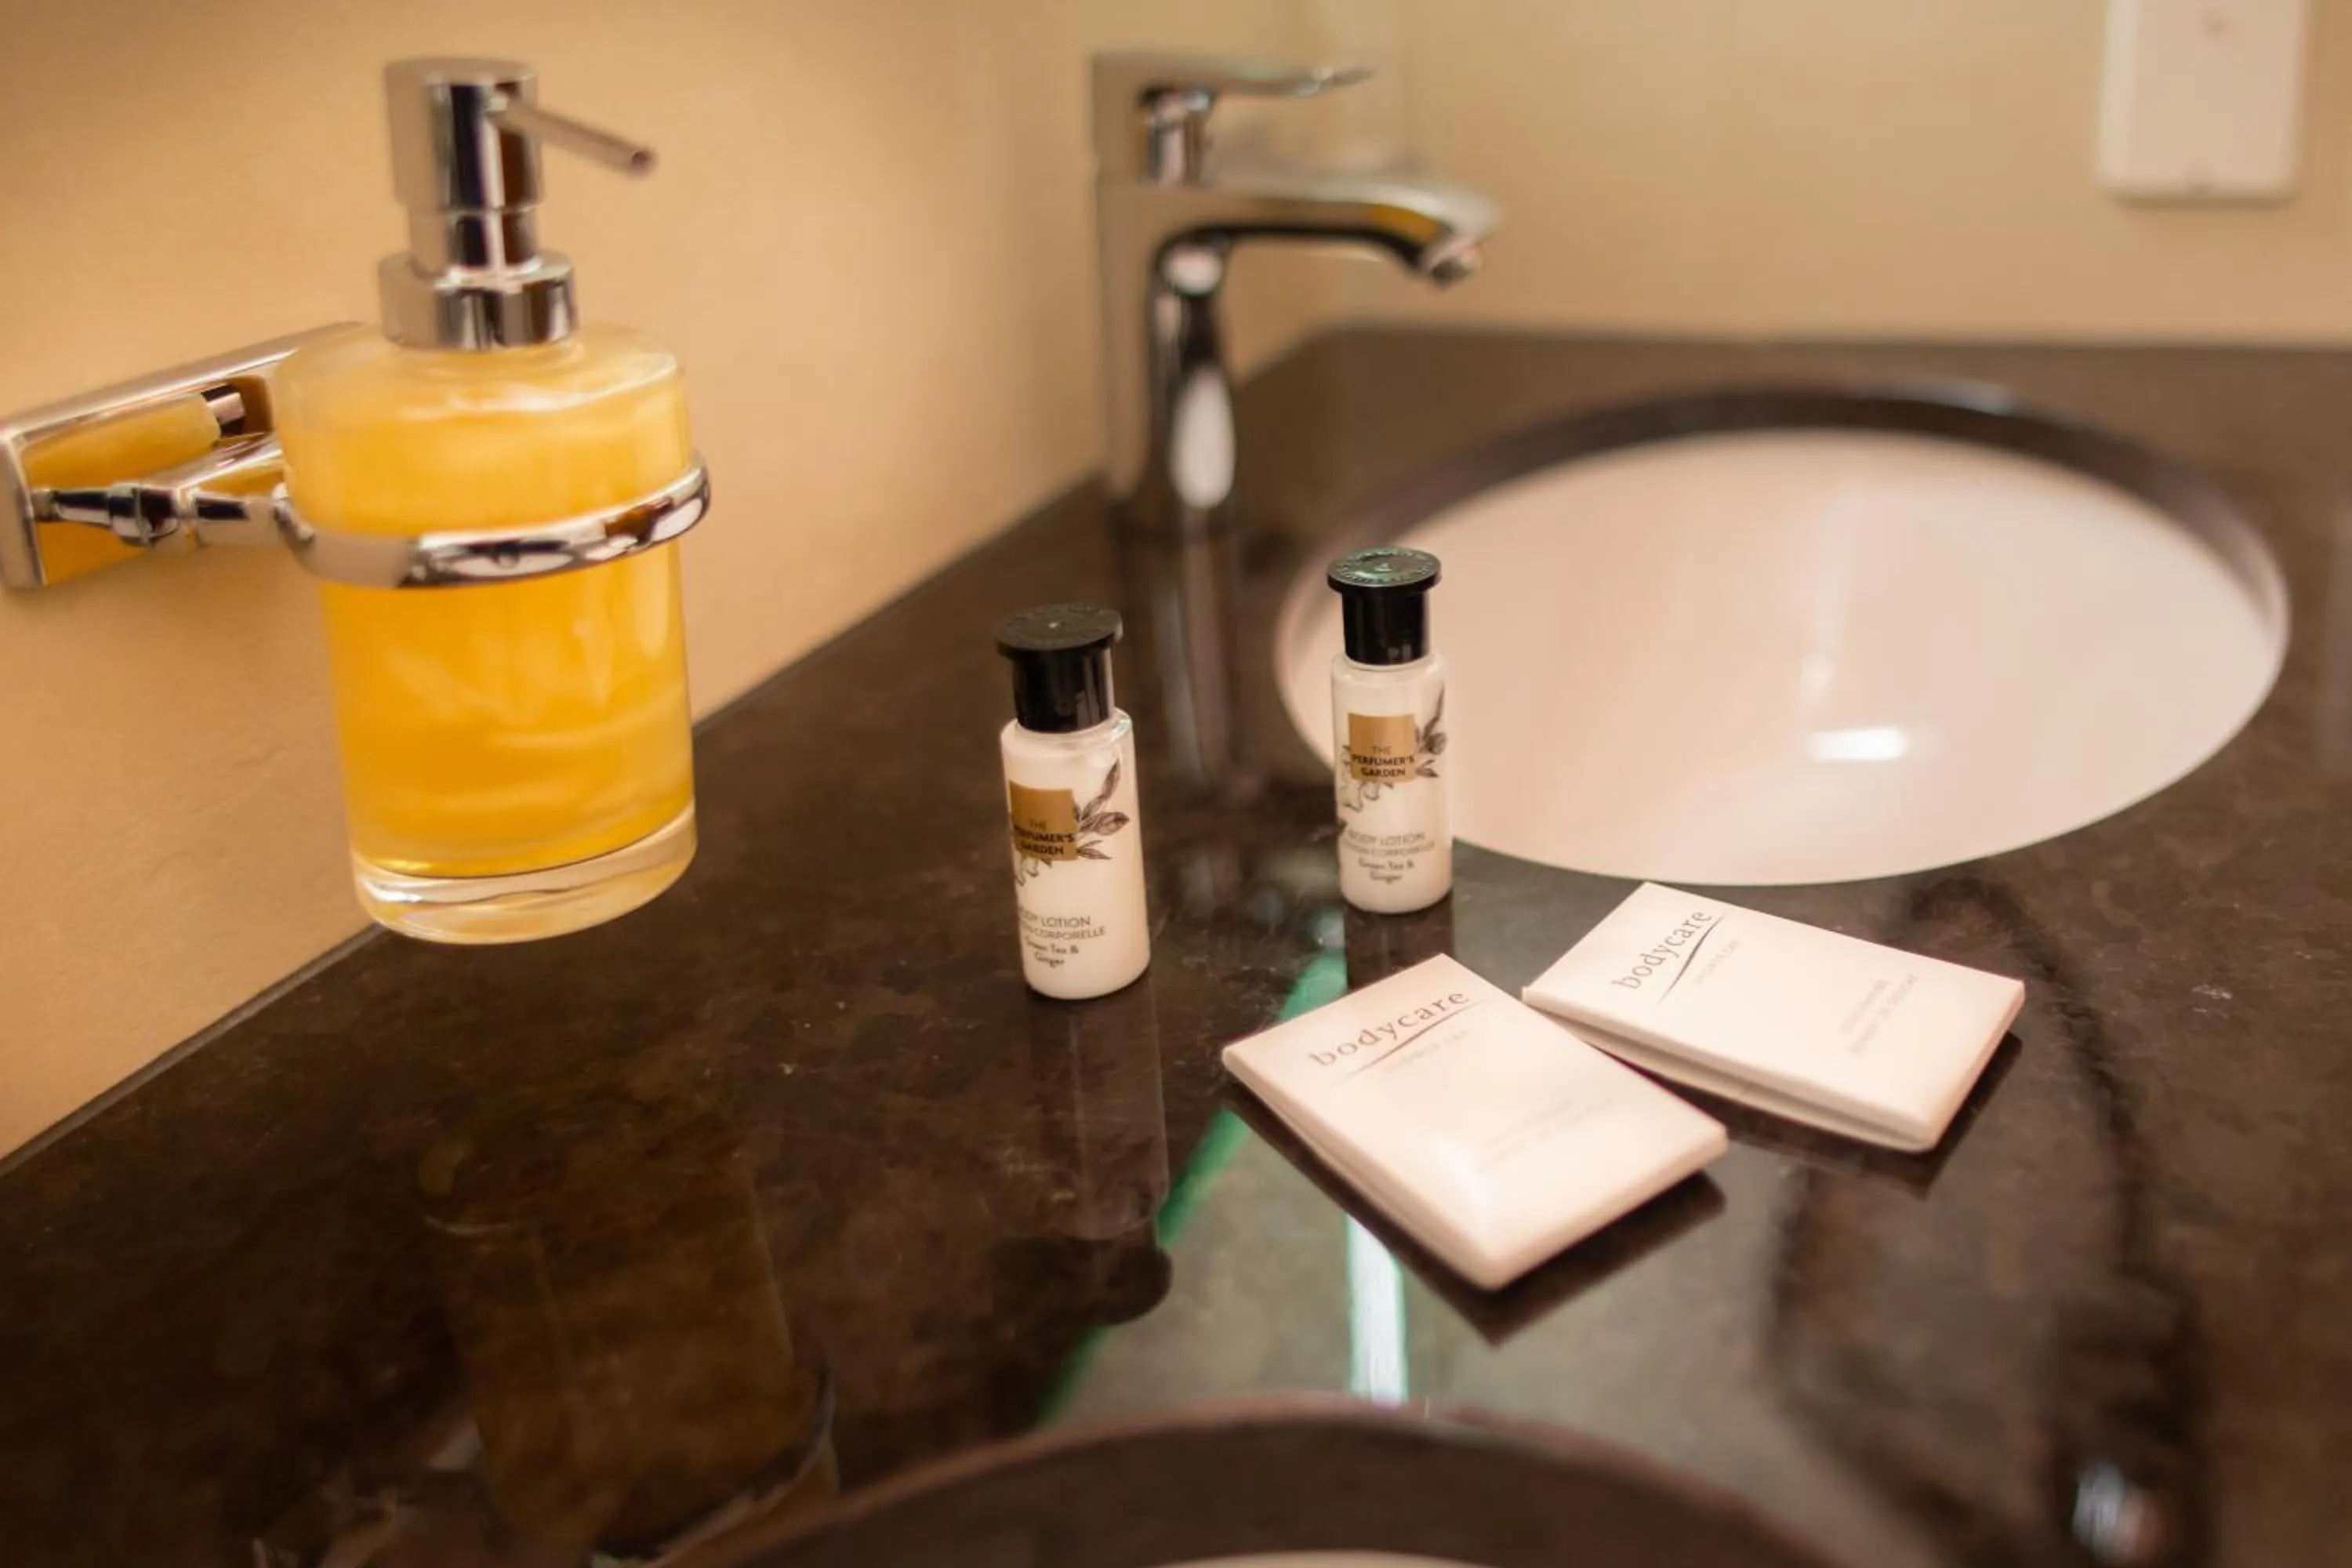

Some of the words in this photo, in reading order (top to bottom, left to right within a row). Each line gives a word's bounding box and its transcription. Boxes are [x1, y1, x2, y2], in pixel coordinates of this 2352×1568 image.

[1351, 753, 1414, 765] PERFUMER'S
[1360, 766, 1406, 777] GARDEN
[1041, 916, 1091, 927] LOTION
[1611, 912, 1712, 989] bodycare
[1308, 992, 1469, 1066] bodycare
